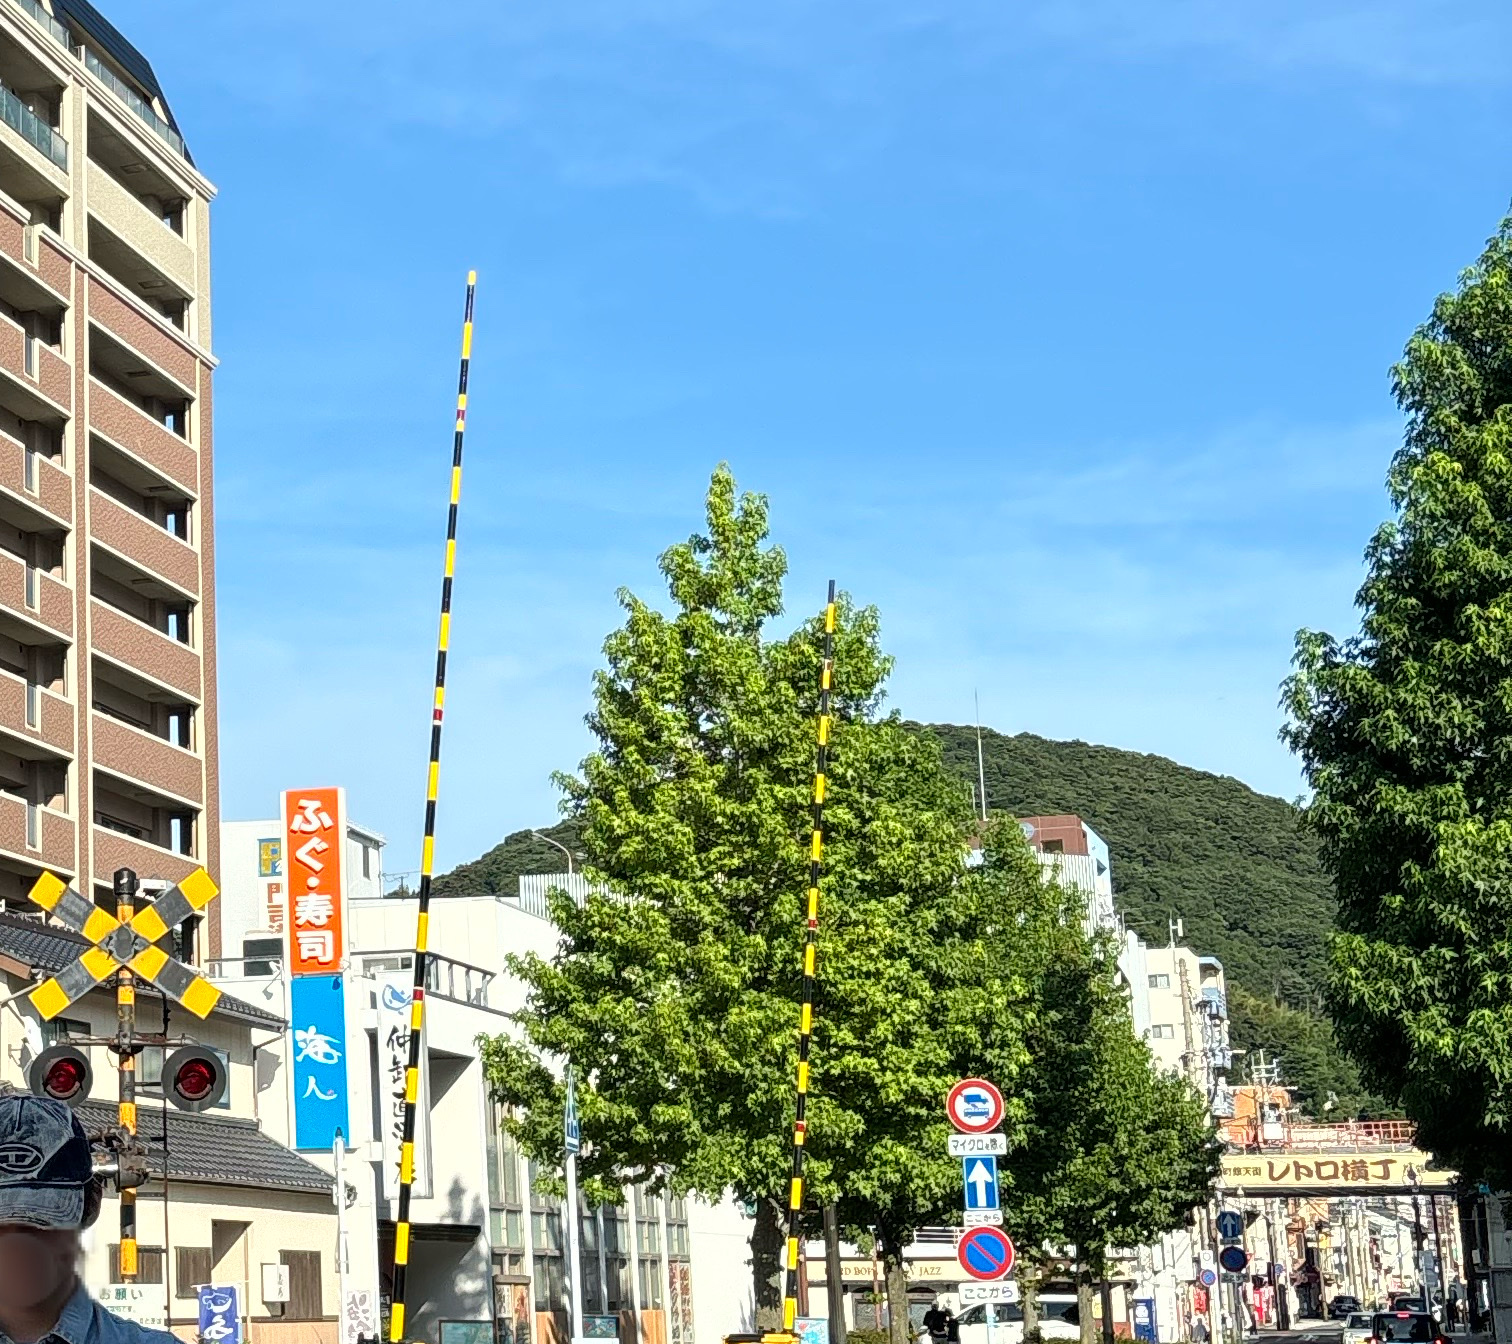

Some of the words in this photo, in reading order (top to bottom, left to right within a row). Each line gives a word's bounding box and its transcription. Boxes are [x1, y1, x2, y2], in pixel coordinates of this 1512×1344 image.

[289, 799, 334, 965] ふぐ・寿司
[1266, 1159, 1398, 1183] レトロ横丁
[966, 1213, 1001, 1223] ここから
[919, 1266, 943, 1277] JAZZ
[964, 1286, 1013, 1301] ここから
